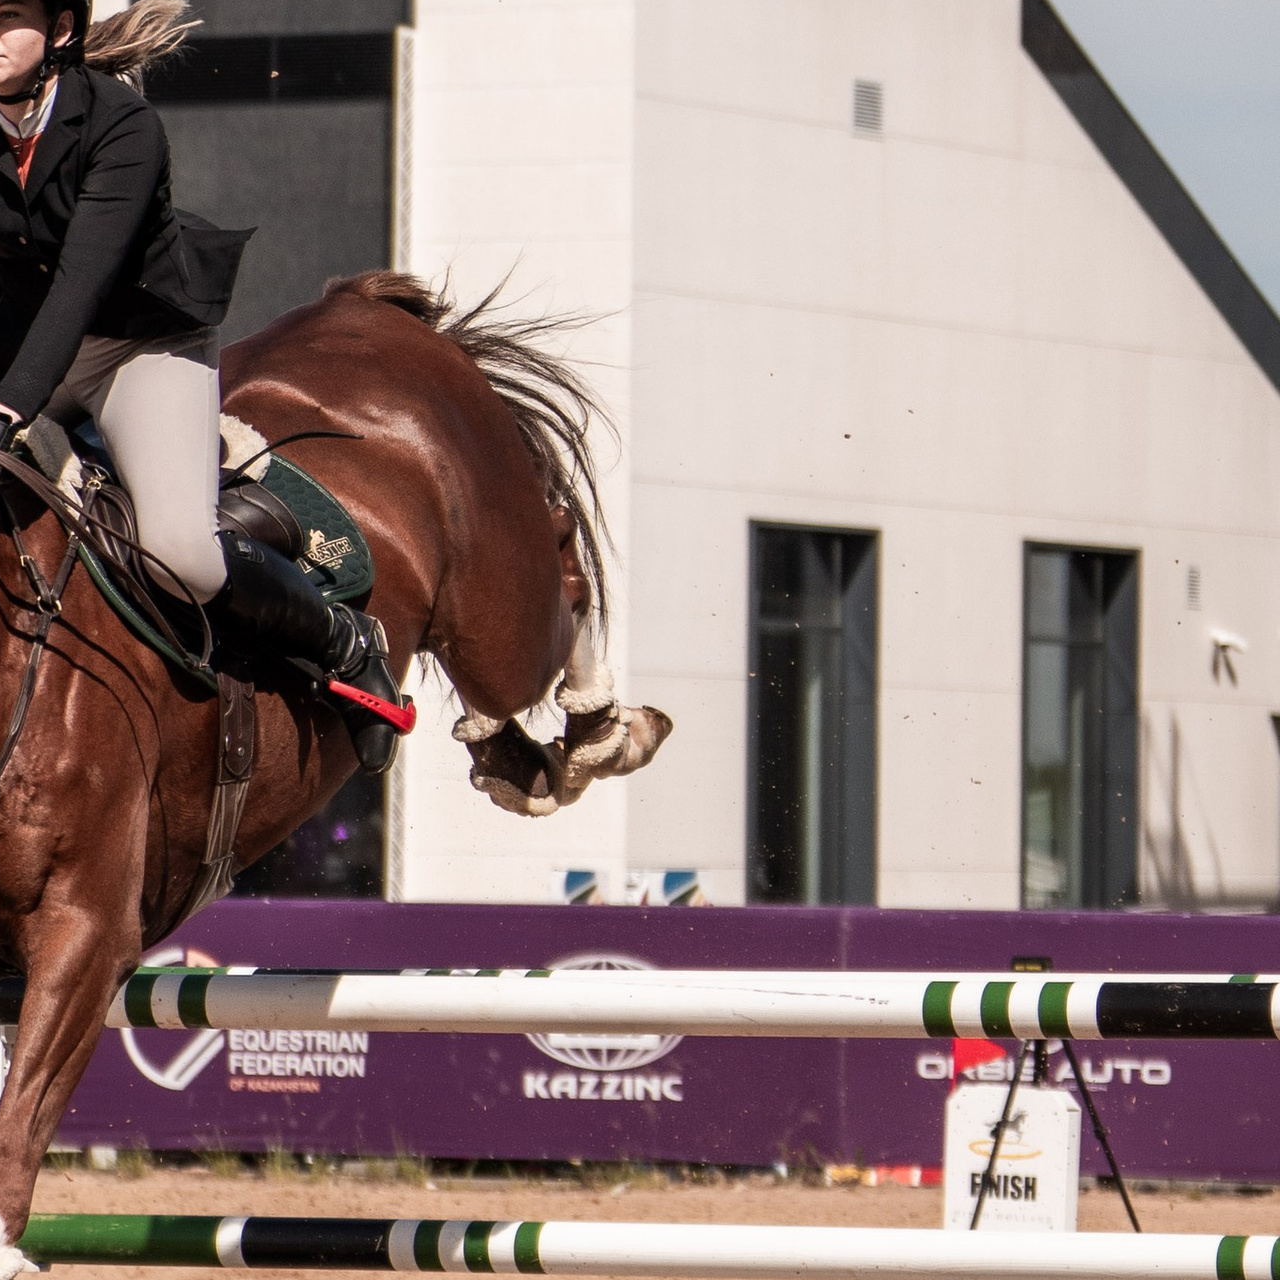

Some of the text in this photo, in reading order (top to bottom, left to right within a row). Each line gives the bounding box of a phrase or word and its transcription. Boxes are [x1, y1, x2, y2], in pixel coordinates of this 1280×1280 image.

[229, 1030, 369, 1054] EQUESTRIAN
[229, 1052, 366, 1078] FEDERATION
[1056, 1058, 1172, 1085] AUTO
[523, 1073, 683, 1101] KAZZINC
